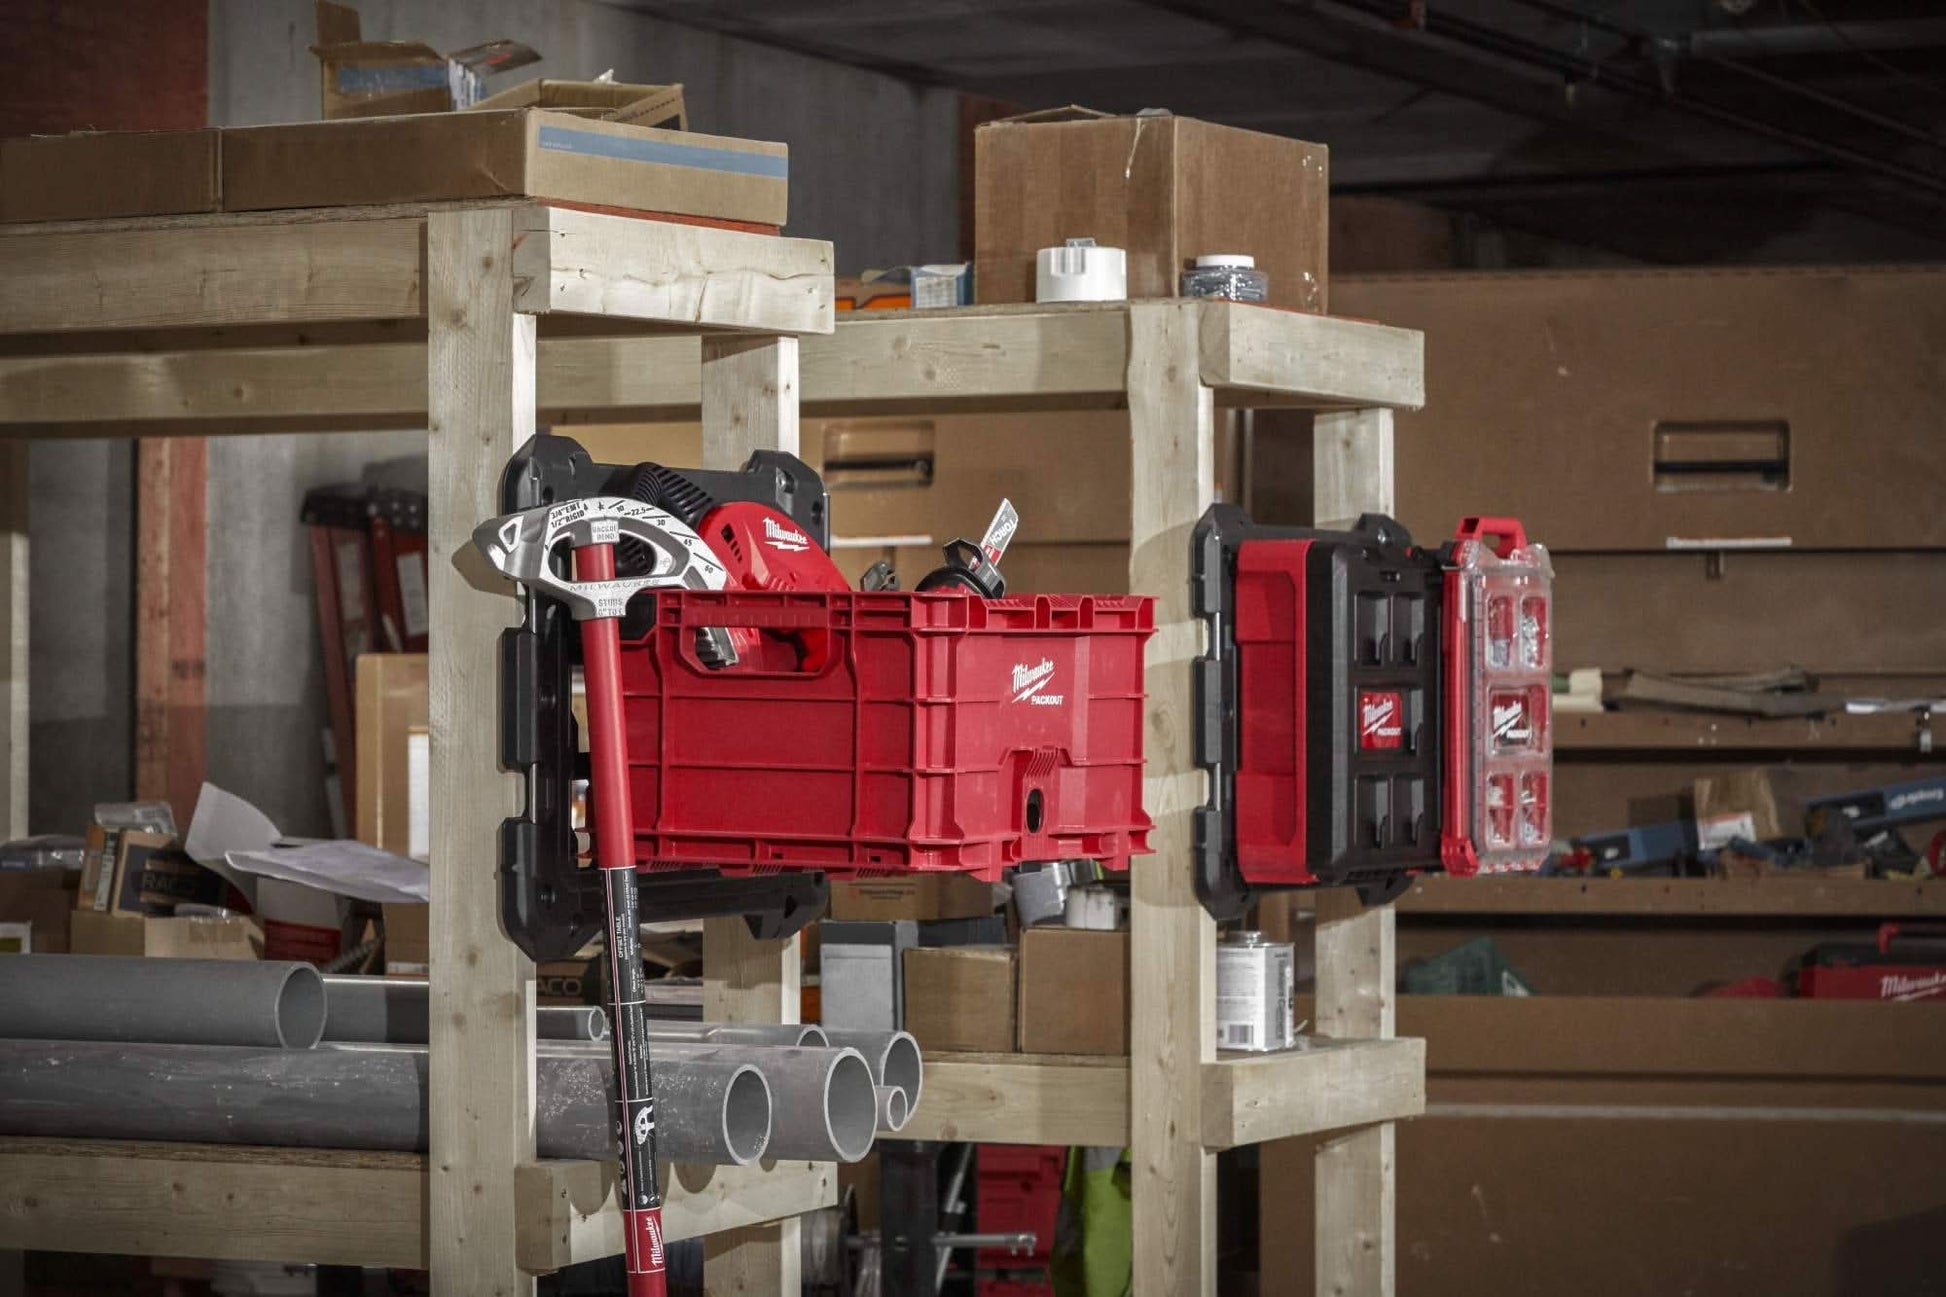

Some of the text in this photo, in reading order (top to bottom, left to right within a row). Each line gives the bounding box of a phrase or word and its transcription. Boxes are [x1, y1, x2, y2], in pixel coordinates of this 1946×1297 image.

[616, 505, 625, 513] 10
[631, 507, 646, 516] 22.5
[762, 516, 808, 545] Milwaukee
[989, 519, 1016, 546] TORCH
[683, 538, 693, 547] 45
[1011, 657, 1054, 694] Milwaukee
[1031, 695, 1064, 706] PACKOUT
[537, 977, 583, 997] ACO
[1880, 970, 1946, 998] Milwauke
[645, 1215, 664, 1267] Milwaukee
